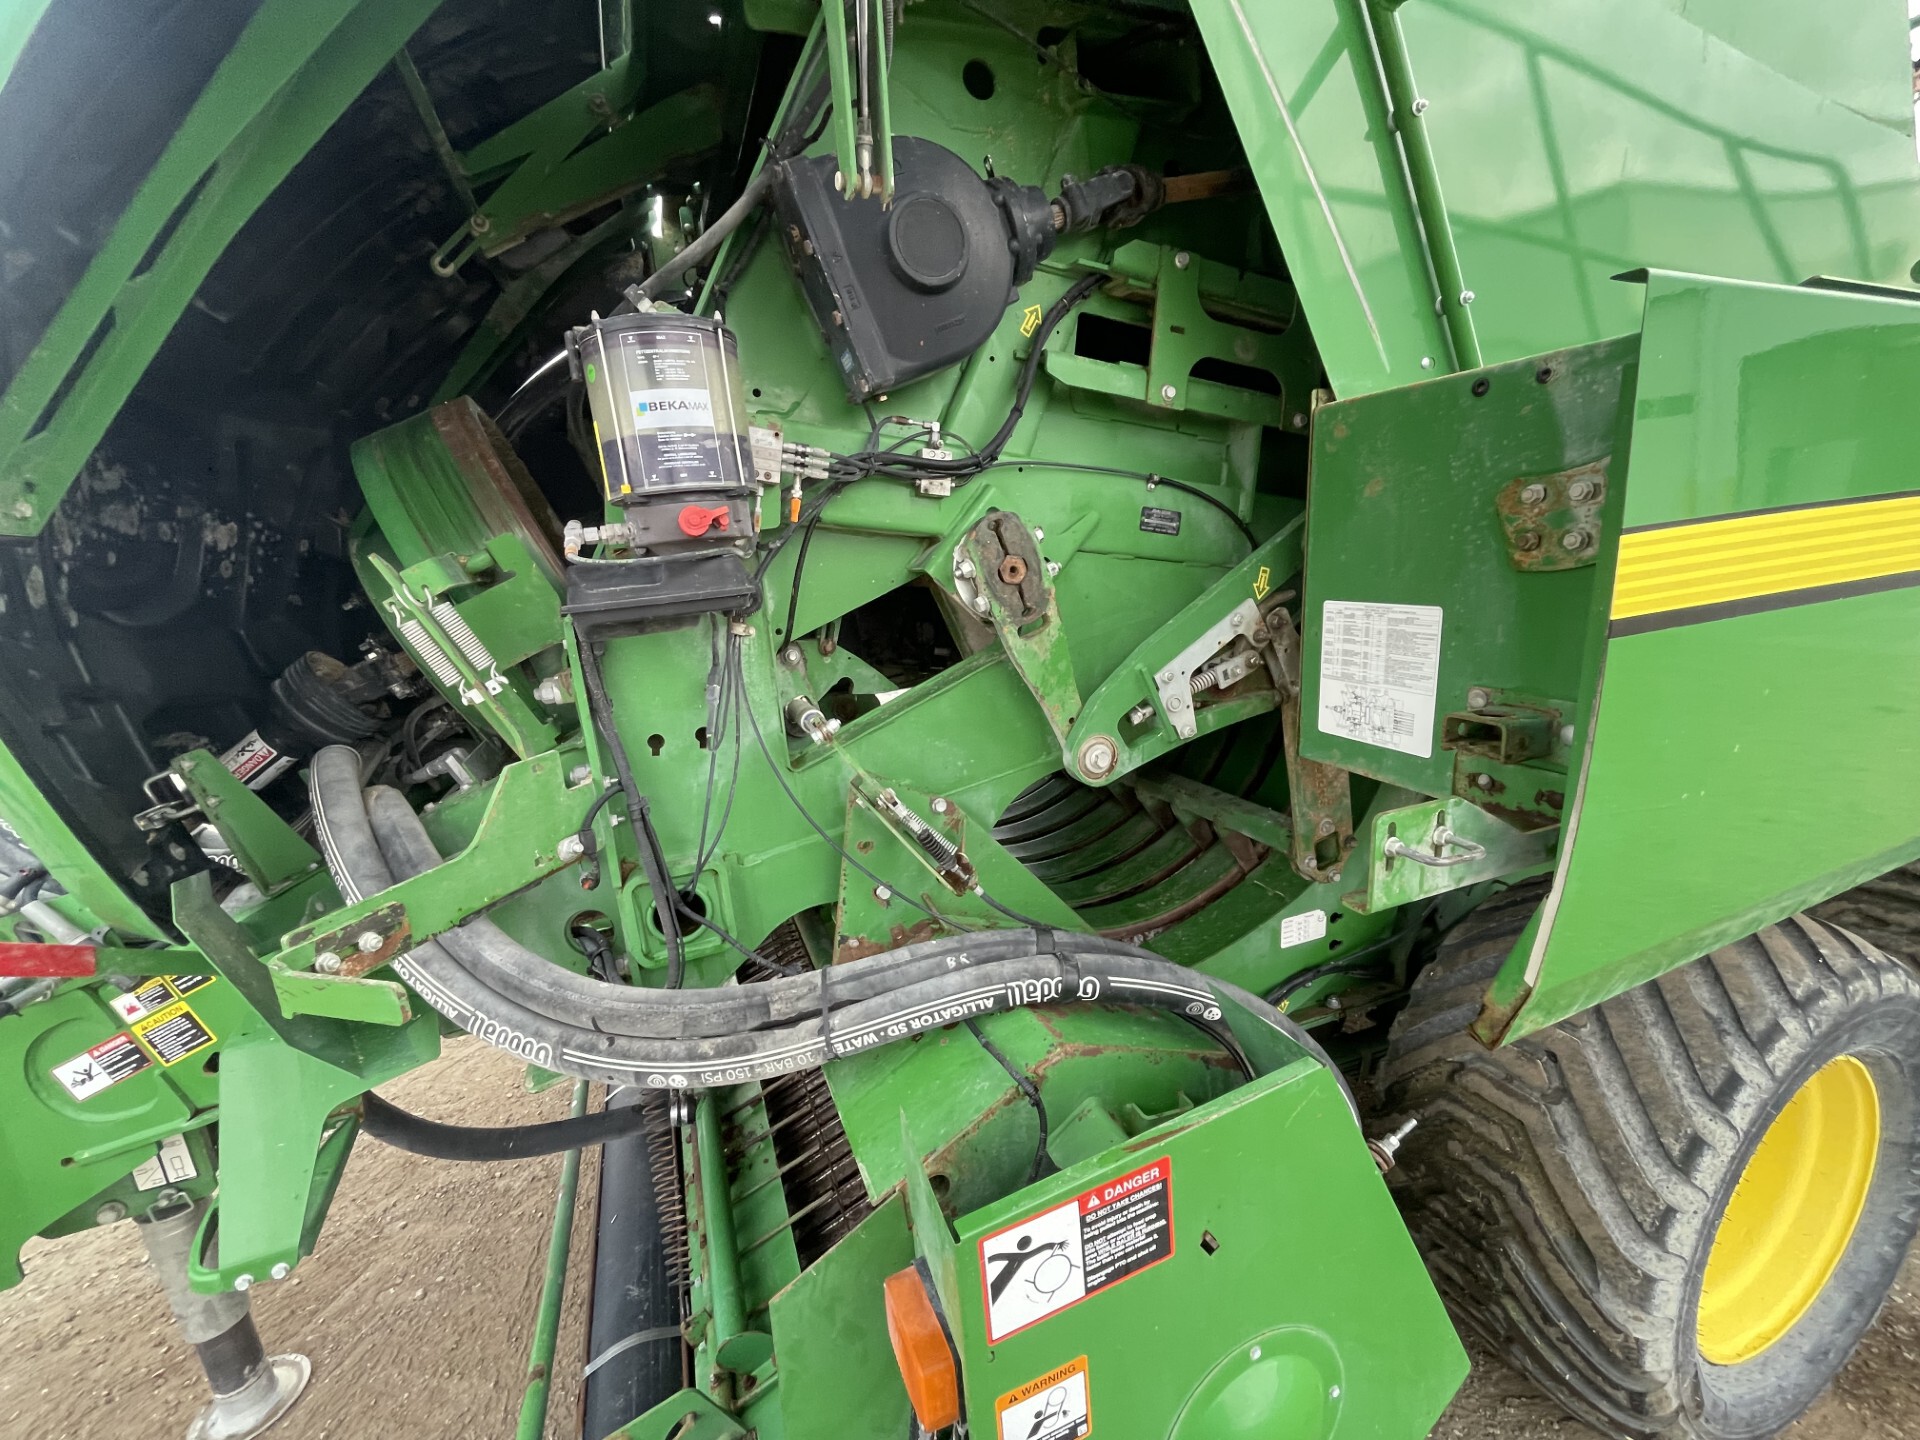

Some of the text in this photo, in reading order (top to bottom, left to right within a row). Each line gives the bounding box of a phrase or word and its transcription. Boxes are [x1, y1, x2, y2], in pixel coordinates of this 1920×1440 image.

[648, 400, 709, 412] BEKAMAX
[392, 956, 459, 1019] ALLIGATOR
[146, 1005, 184, 1029] CAUTION
[830, 996, 995, 1055] ALLIGATOR SD WATE
[765, 1057, 794, 1074] BAR
[797, 1051, 816, 1065] 10
[700, 1071, 722, 1084] PSI
[726, 1067, 752, 1083] 150
[1104, 1167, 1160, 1201] DANGER
[1086, 1213, 1097, 1222] DO
[1097, 1206, 1111, 1217] NOT
[1111, 1197, 1129, 1209] TAKE
[1021, 1363, 1077, 1397] WARNING
